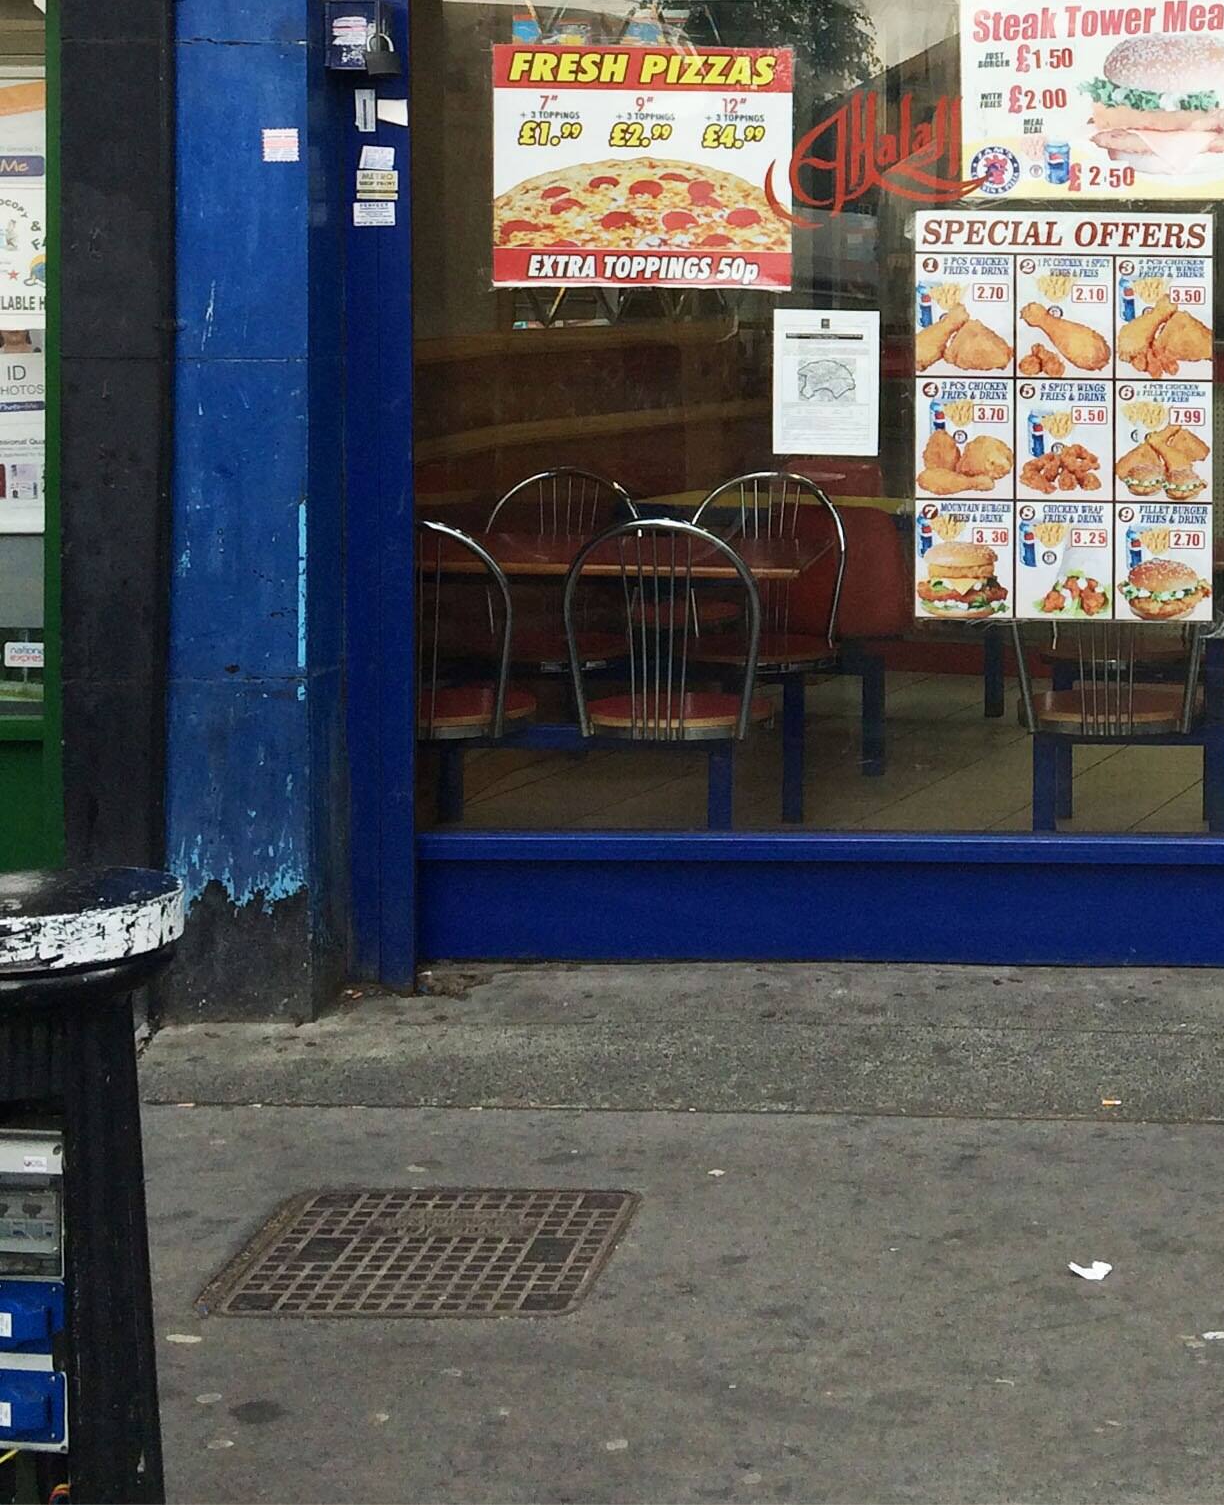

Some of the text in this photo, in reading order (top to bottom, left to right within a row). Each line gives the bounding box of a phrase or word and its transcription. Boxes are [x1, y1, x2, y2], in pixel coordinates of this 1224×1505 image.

[973, 8, 1057, 43] Steak
[1065, 2, 1155, 38] Tower
[985, 52, 1004, 60] JUST
[509, 52, 777, 86] FRESH PIZZAS
[539, 111, 580, 120] TOPPINGS
[635, 112, 676, 121] TOPPINGS
[724, 113, 765, 123] TOPPINGS
[518, 121, 583, 146] £1.99
[609, 123, 673, 148] £2.99
[701, 124, 767, 149] £4.99
[922, 219, 1207, 248] SPECIAL OFFERS
[969, 257, 1010, 267] CHICKEN
[1021, 260, 1033, 273] 2
[1120, 261, 1133, 274] 3
[528, 255, 760, 284] EXTRA TOPPINGS 50p
[943, 266, 969, 275] FRIES
[980, 267, 1010, 276] DRINK
[976, 286, 1004, 300] 2.70
[1075, 287, 1105, 301] 2.10
[1172, 289, 1202, 303] 3.50
[7, 365, 26, 381] ID
[924, 382, 937, 396] 4
[941, 382, 1009, 391] 3 PCS CHICKEN
[1022, 384, 1034, 398] 5
[1048, 383, 1107, 392] SPICY WINGS
[1121, 386, 1133, 399] 6
[941, 390, 968, 400] FRIES
[979, 391, 1009, 400] DRINK
[1040, 392, 1068, 401] FRIES
[1077, 393, 1107, 402] DRINK
[977, 407, 1005, 421] 3.70
[1074, 409, 1105, 422] 3.50
[1173, 410, 1202, 423] 7.99
[924, 505, 936, 519] 7
[940, 503, 980, 513] MOUNTAIN
[1022, 506, 1034, 520] 8
[1043, 504, 1104, 514] CHICKEN WRAP
[1121, 508, 1133, 521] 9
[1138, 505, 1209, 515] FILLET BURGER
[1043, 514, 1104, 524] FRIES DRINK
[1140, 515, 1167, 524] FRIES
[1178, 515, 1207, 524] DRINK
[1074, 531, 1107, 545] 3.25
[1173, 533, 1201, 546] 2.70
